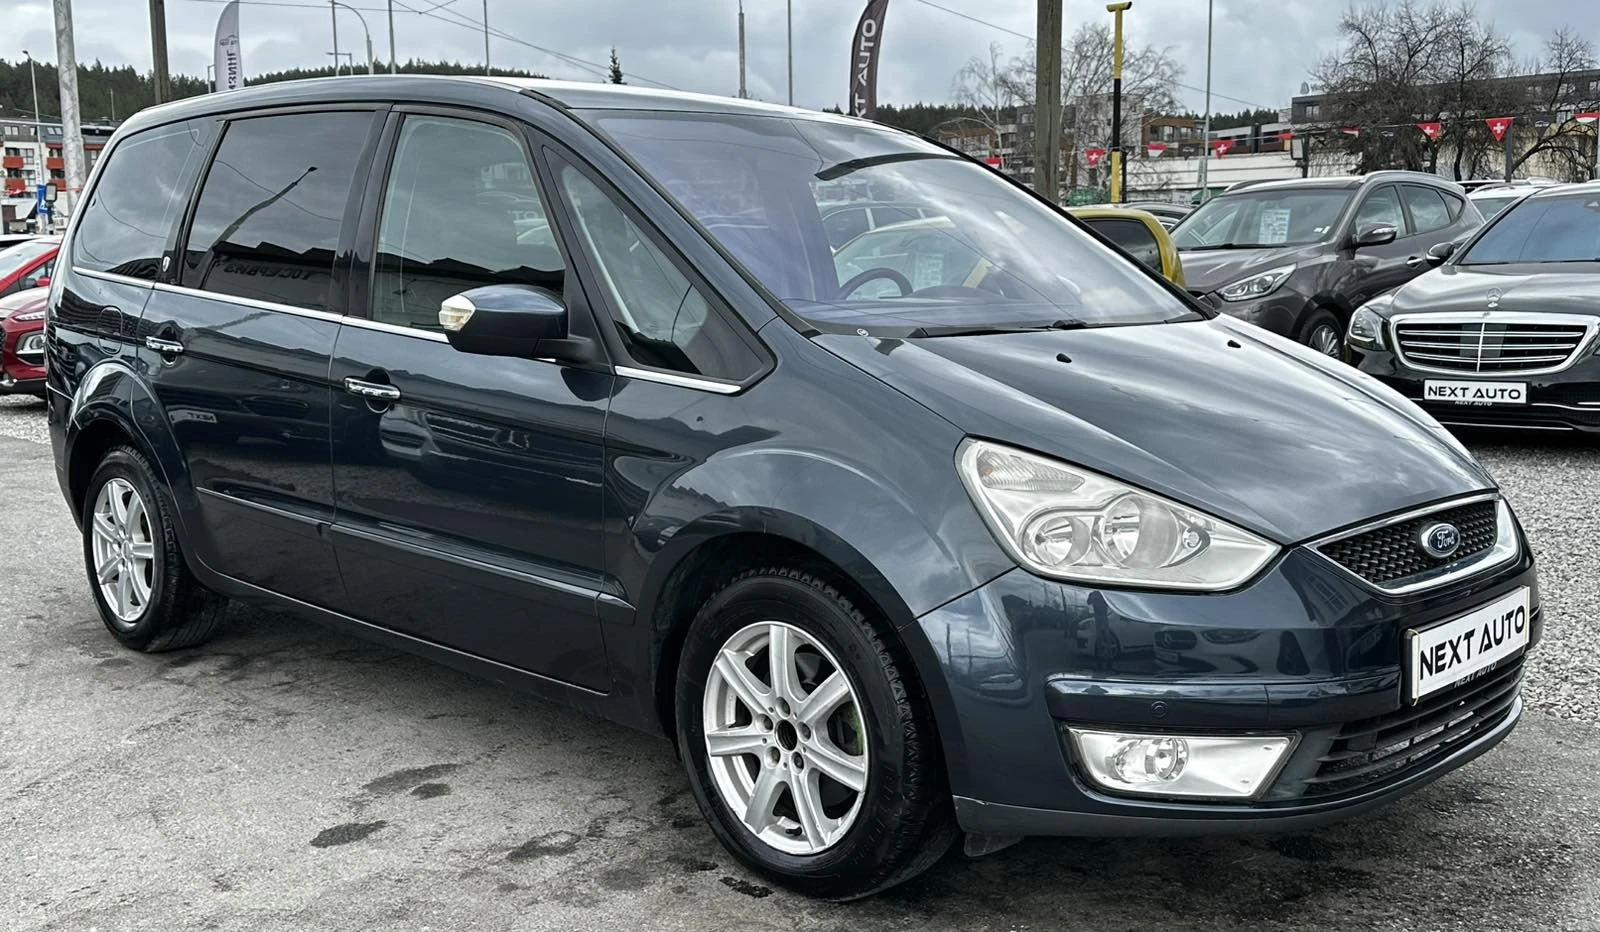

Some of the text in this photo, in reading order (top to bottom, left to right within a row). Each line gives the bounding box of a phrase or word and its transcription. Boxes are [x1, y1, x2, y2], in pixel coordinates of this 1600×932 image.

[858, 19, 876, 86] AUTO
[1428, 386, 1521, 400] NEXT AUTO
[1437, 530, 1455, 548] Ford
[1420, 605, 1525, 680] NEXT AUTO
[1454, 662, 1497, 688] NEXT AUTO
